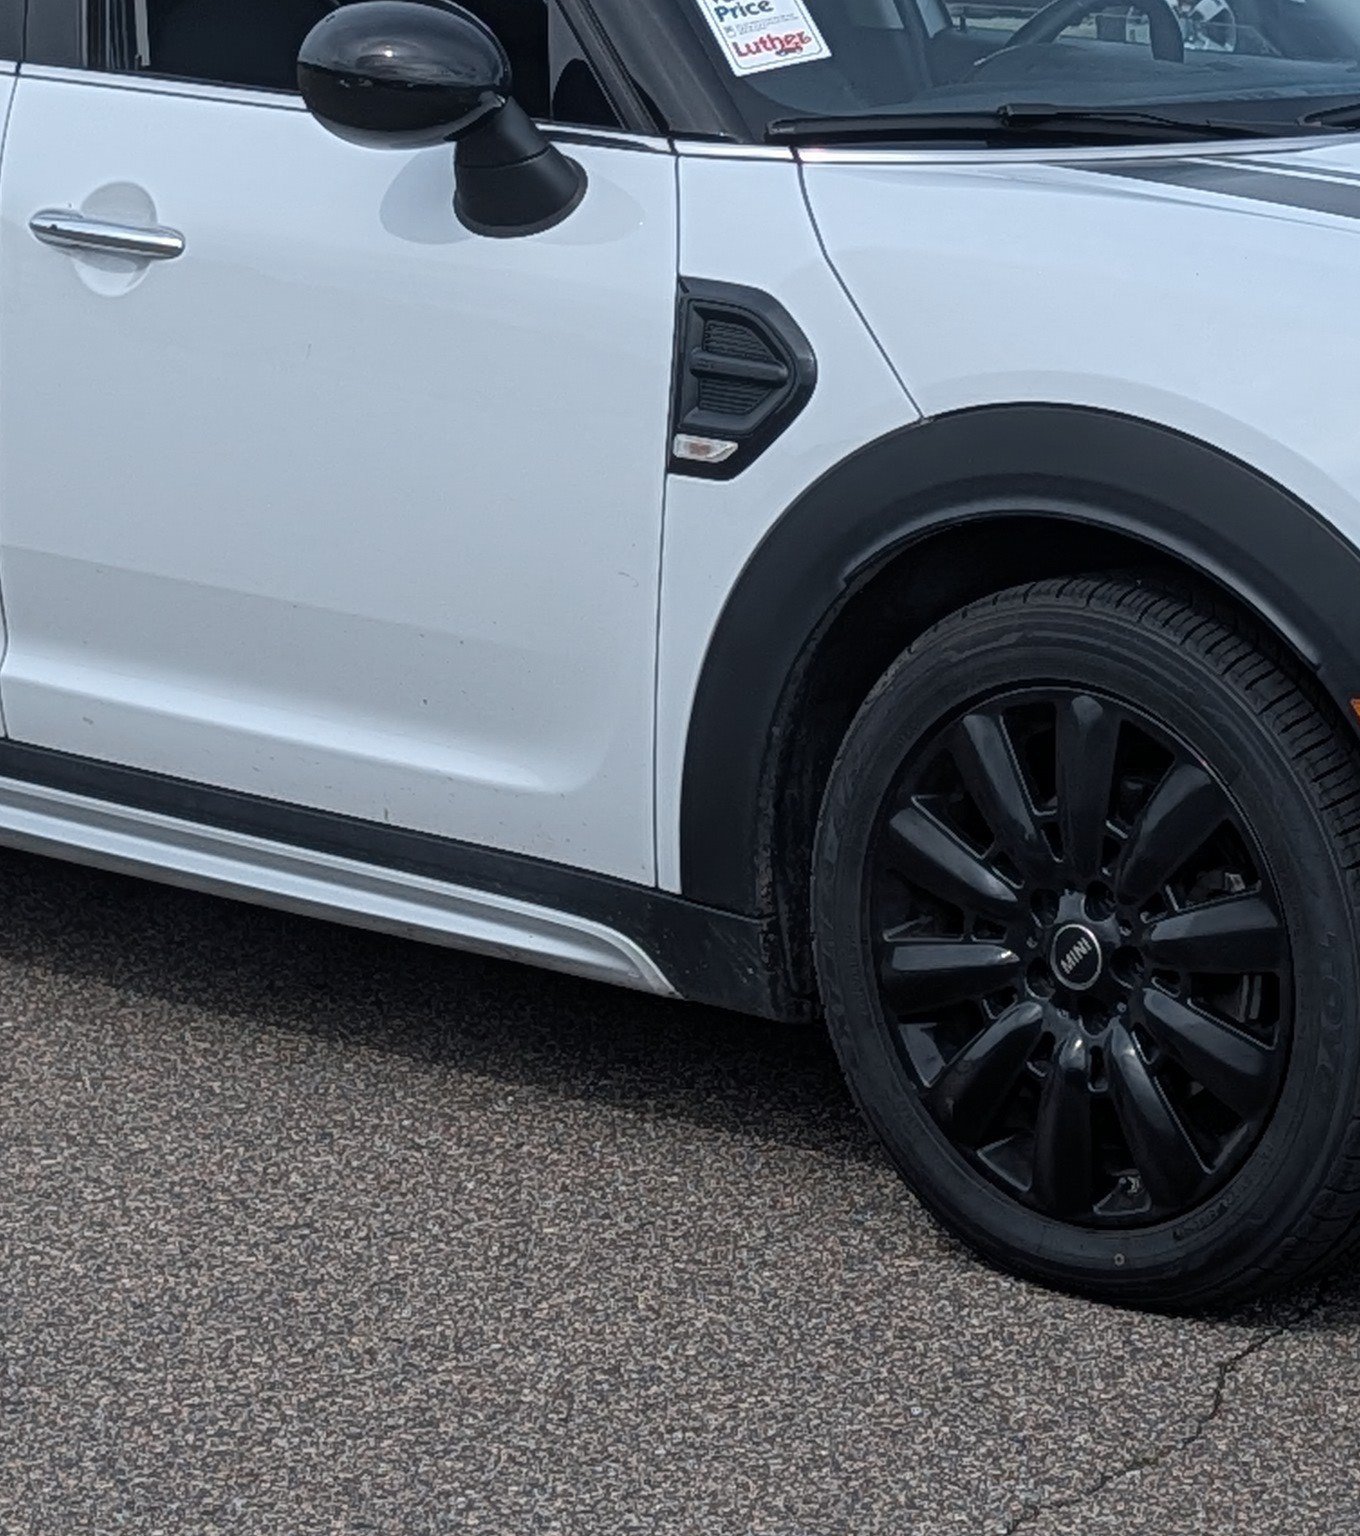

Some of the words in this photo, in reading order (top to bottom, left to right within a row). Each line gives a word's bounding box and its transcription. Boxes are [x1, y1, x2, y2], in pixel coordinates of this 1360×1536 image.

[714, 0, 775, 23] Price
[732, 30, 809, 57] Luther
[1060, 937, 1093, 975] MINI
